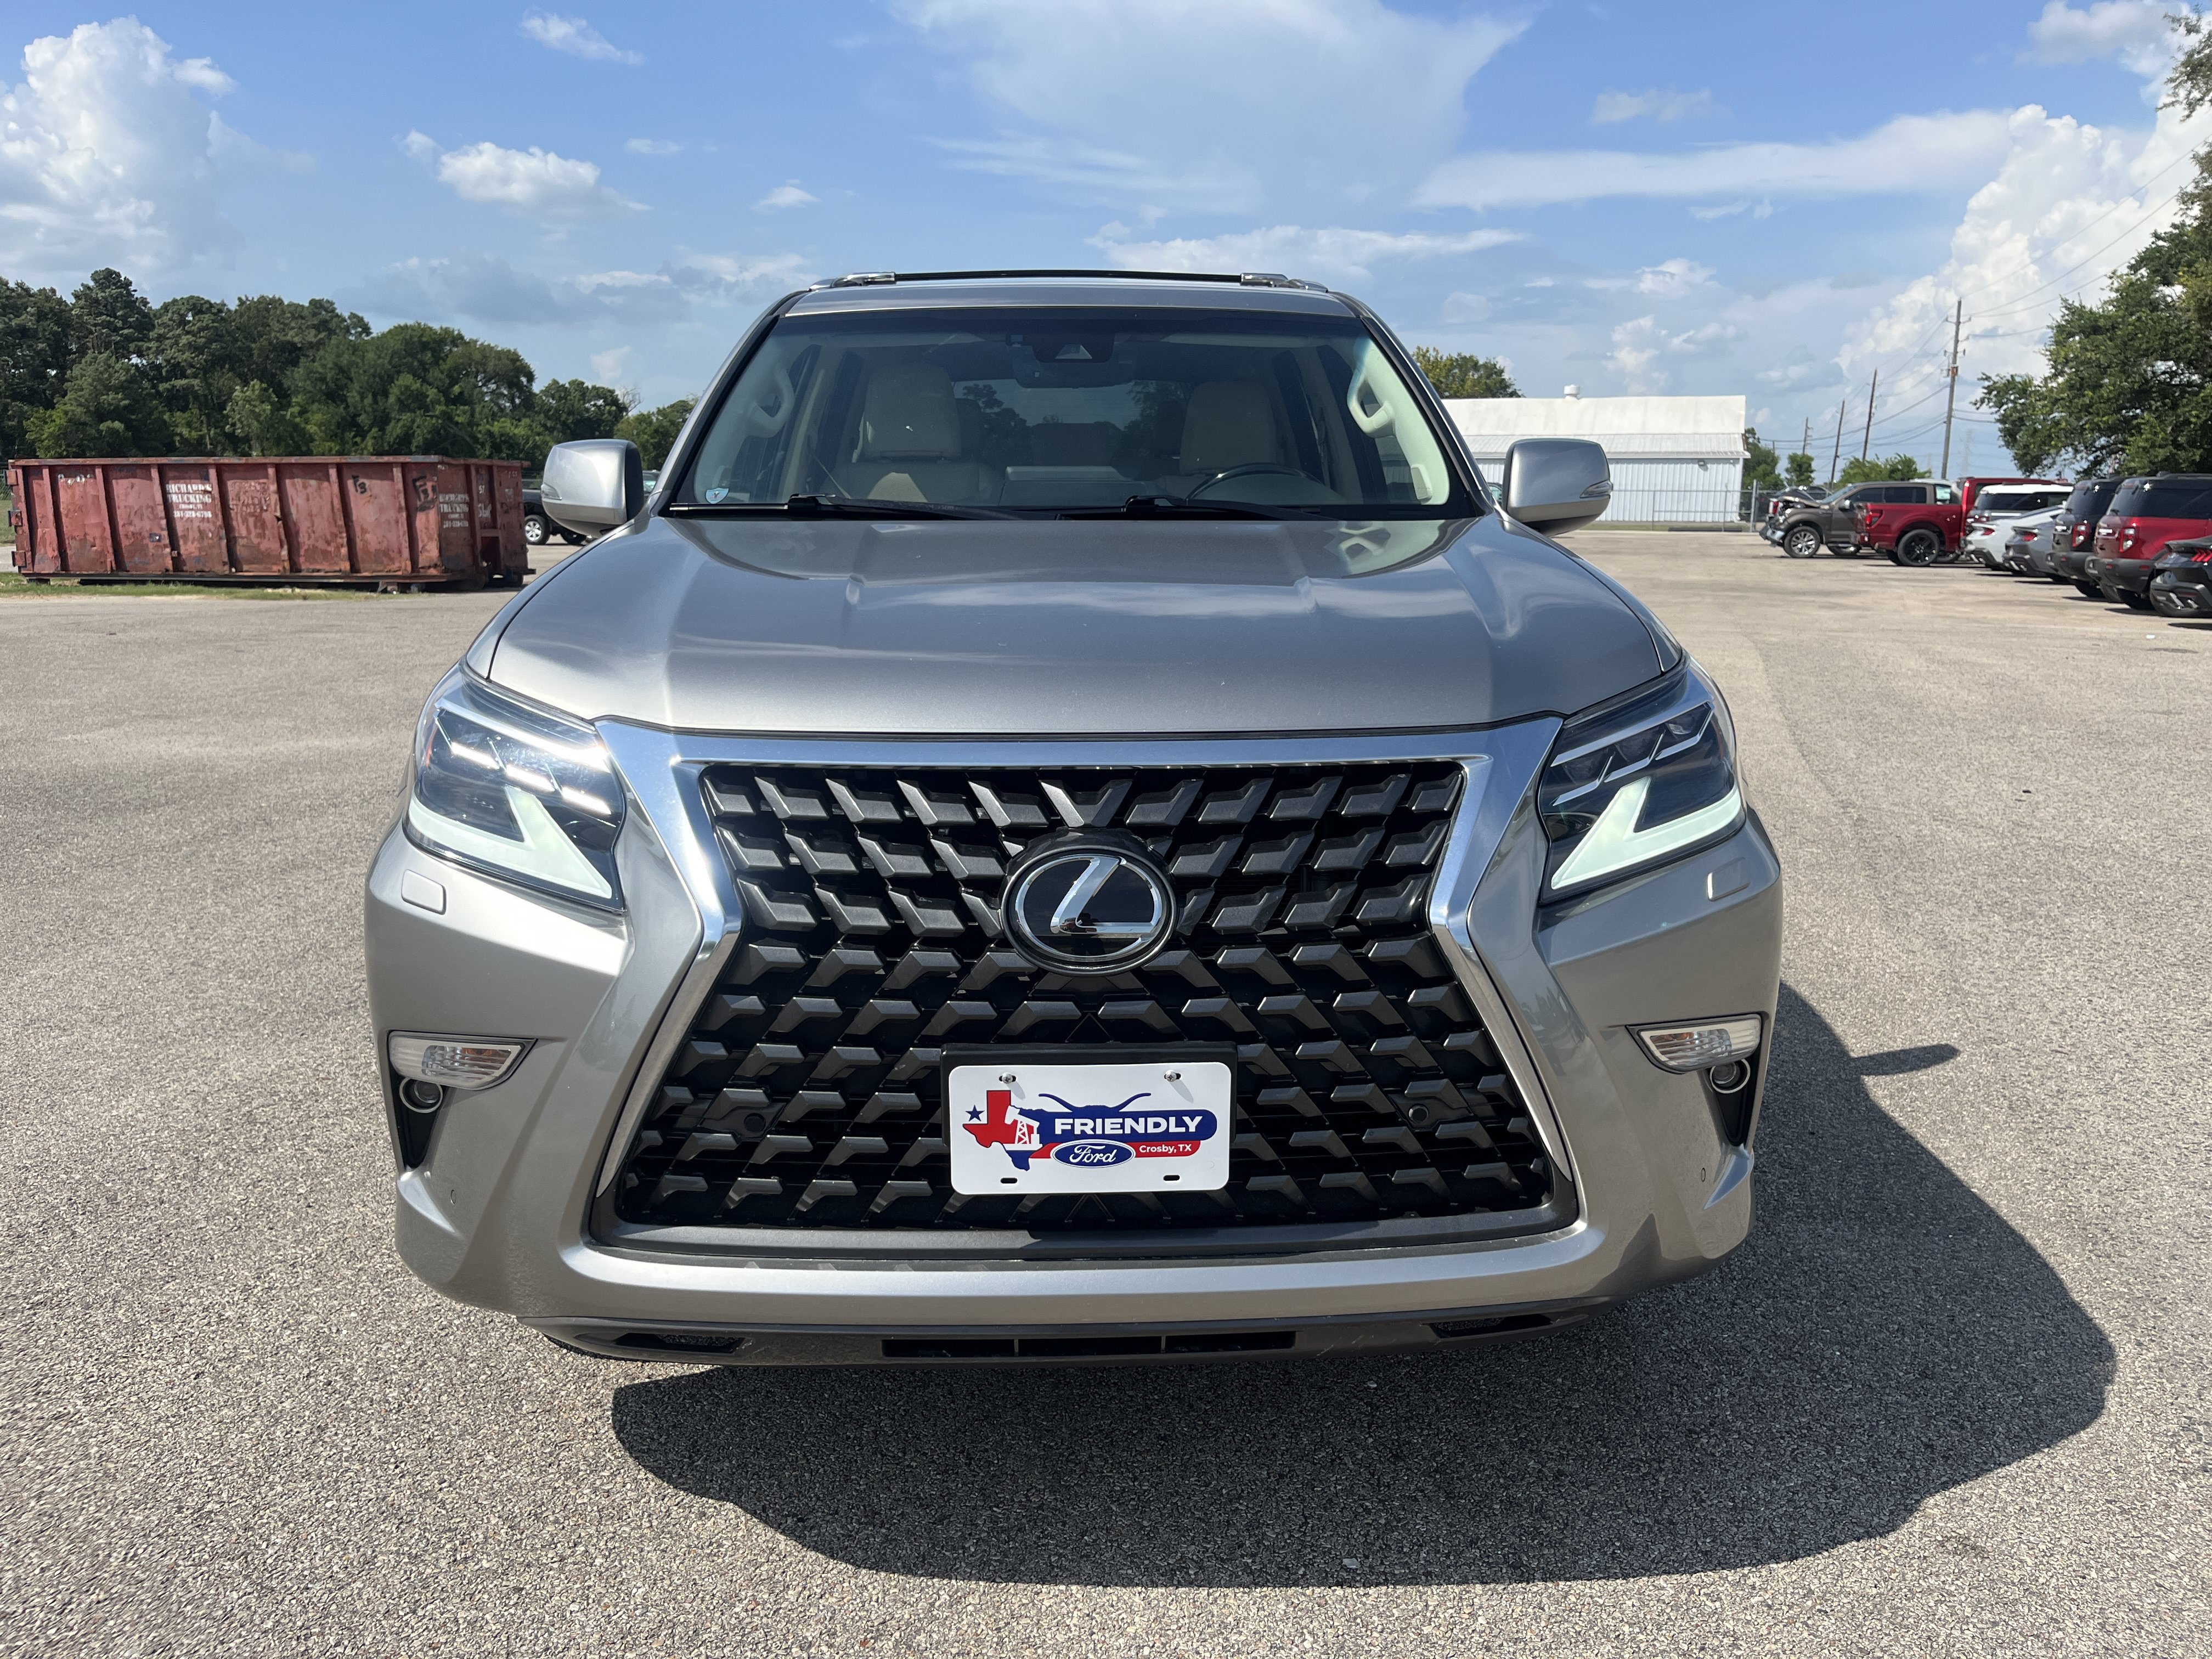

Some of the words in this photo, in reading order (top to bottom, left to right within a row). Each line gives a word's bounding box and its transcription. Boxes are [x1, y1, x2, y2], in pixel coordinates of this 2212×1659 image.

[167, 494, 212, 503] TRUCKING
[1054, 1116, 1203, 1135] FRIENDLY
[1069, 1144, 1117, 1163] Ford
[1139, 1145, 1177, 1154] Crosby,
